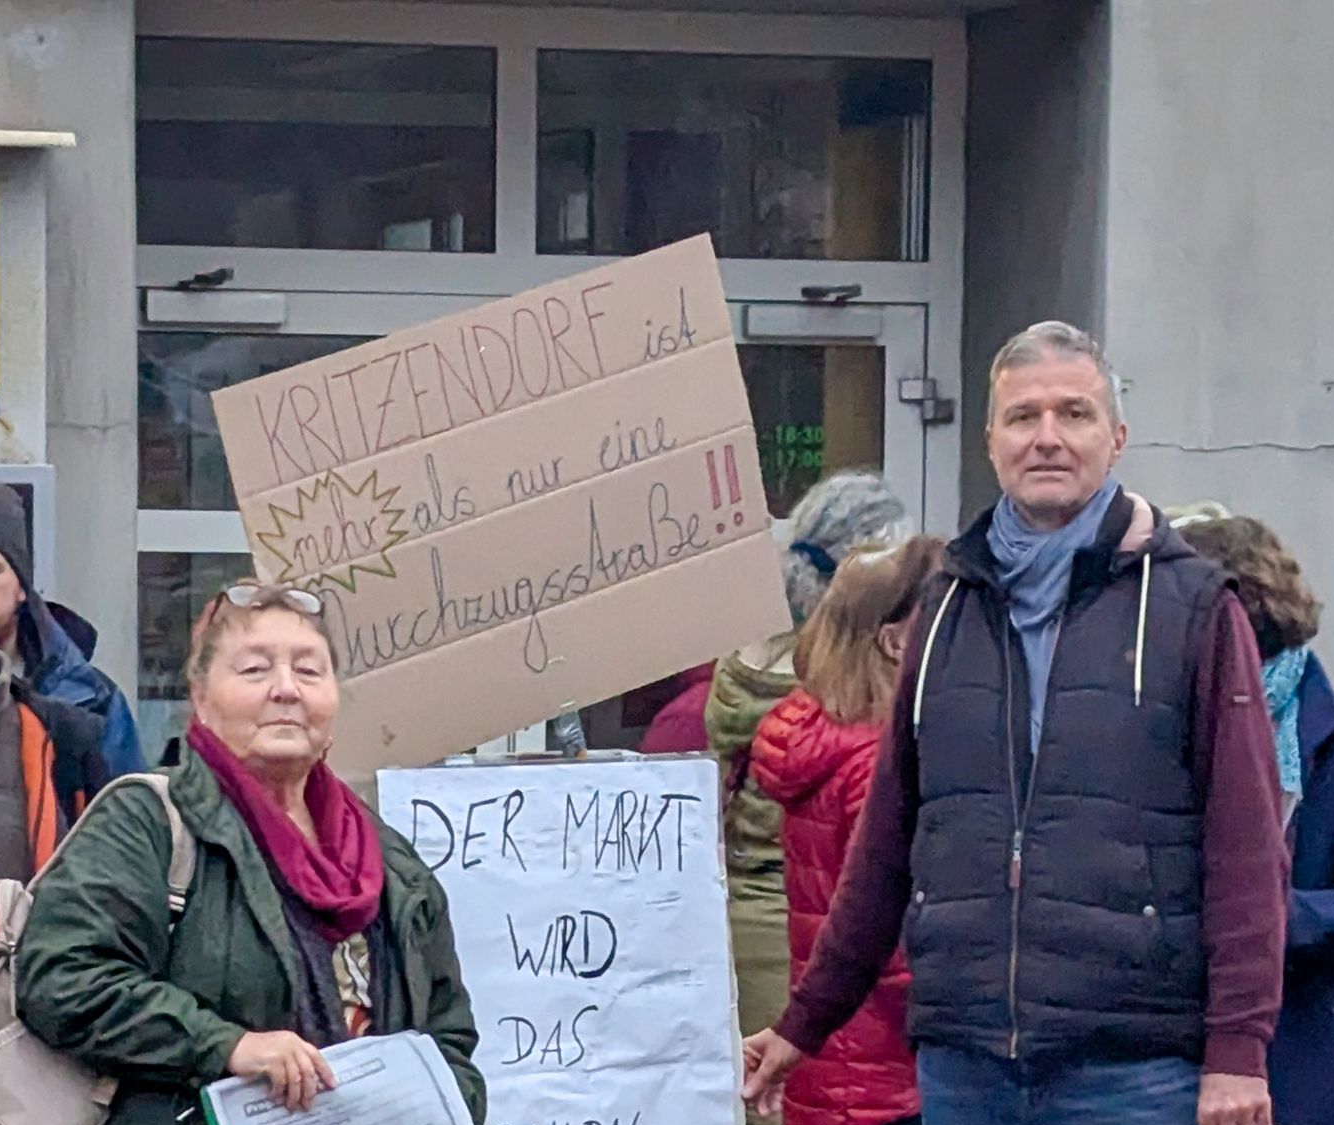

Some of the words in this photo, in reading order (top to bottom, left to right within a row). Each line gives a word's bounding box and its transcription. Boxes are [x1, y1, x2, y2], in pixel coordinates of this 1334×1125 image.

[254, 281, 614, 487] KRITZENDORF
[643, 286, 697, 363] ist
[293, 481, 377, 574] mehr
[412, 452, 475, 532] als
[506, 454, 565, 504] nur
[598, 416, 678, 471] eine
[411, 789, 528, 873] DER
[562, 789, 703, 874] MARKT
[506, 909, 617, 979] WIRD
[497, 1004, 599, 1068] DAS
